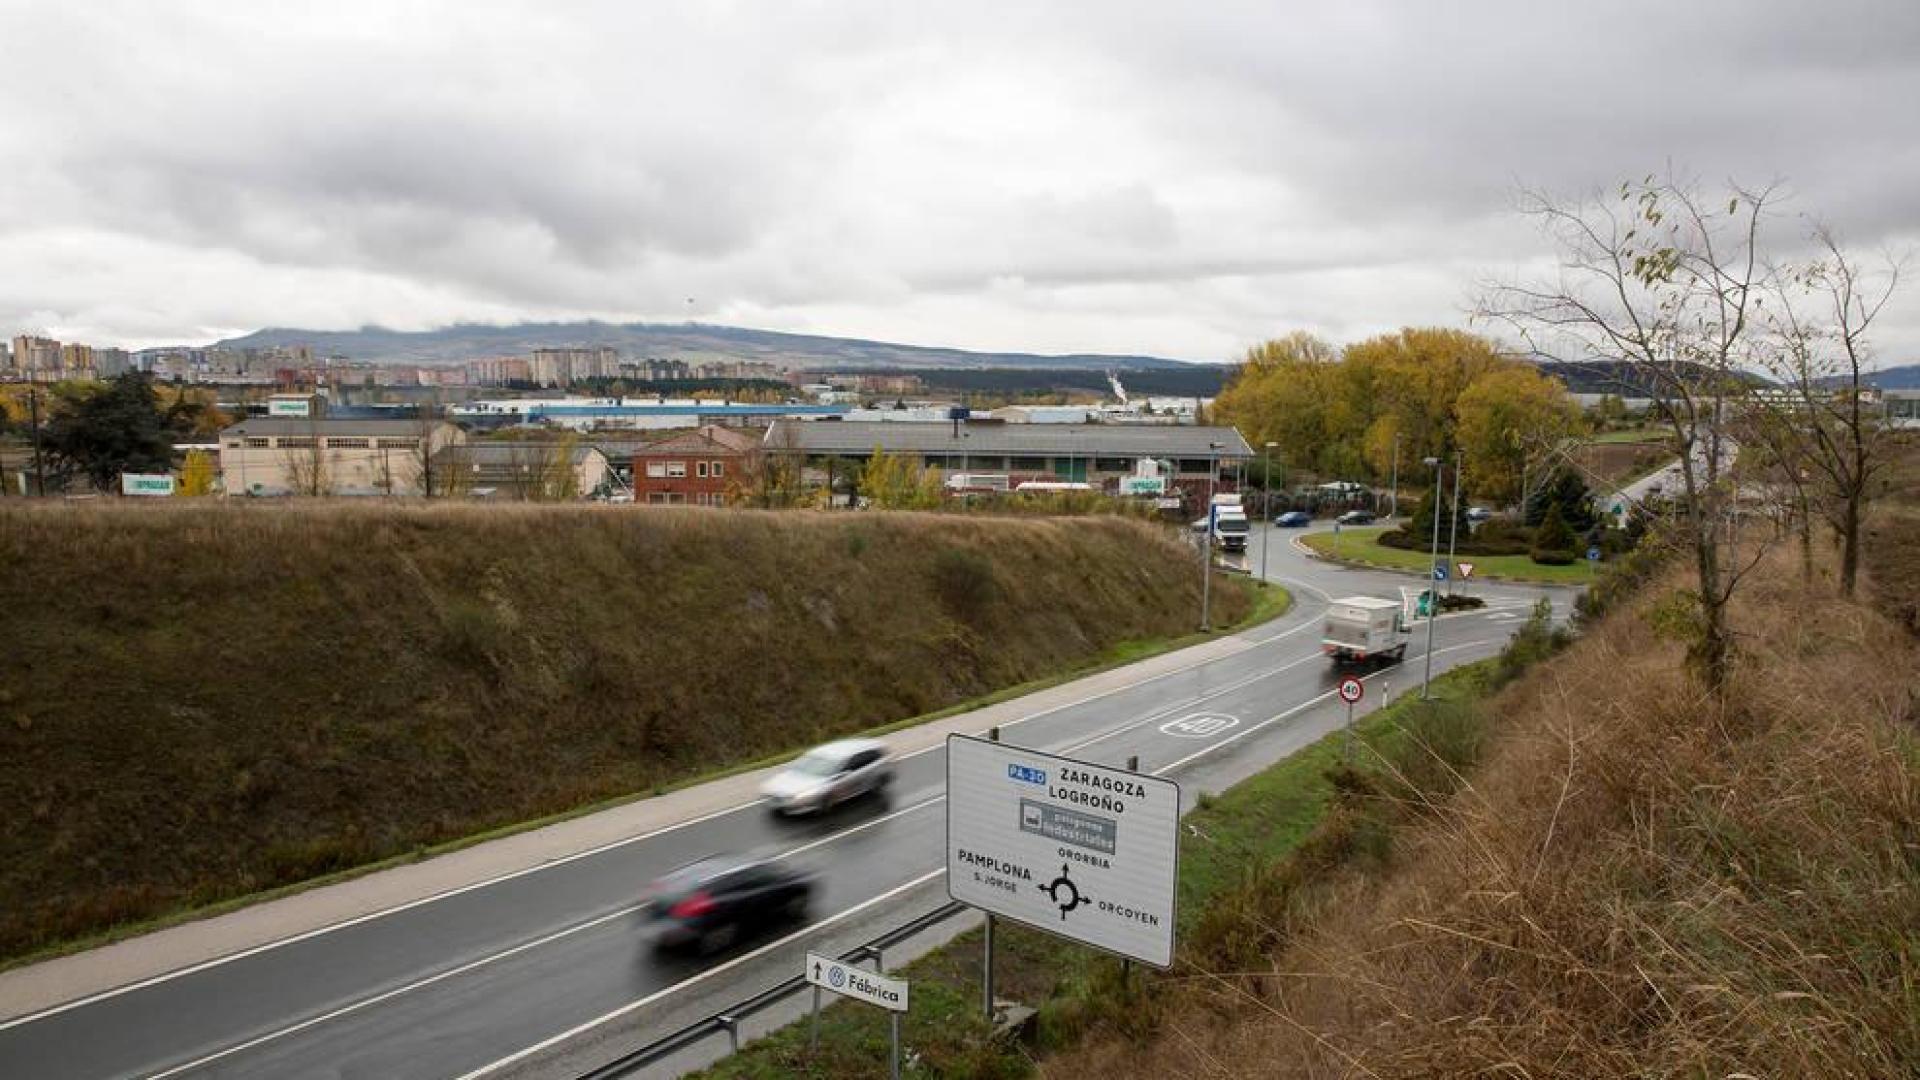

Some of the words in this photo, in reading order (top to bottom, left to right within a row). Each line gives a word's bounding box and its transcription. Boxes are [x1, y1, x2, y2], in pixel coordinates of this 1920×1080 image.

[1344, 684, 1357, 696] 40
[1060, 767, 1146, 799] ZARAGOZA
[1049, 786, 1124, 814] LOGROÑO
[958, 848, 1032, 881] PAMPLONA
[1058, 846, 1111, 869] ORORBIA
[1099, 900, 1160, 926] ORCOYEN
[848, 974, 899, 1002] Fábrica
